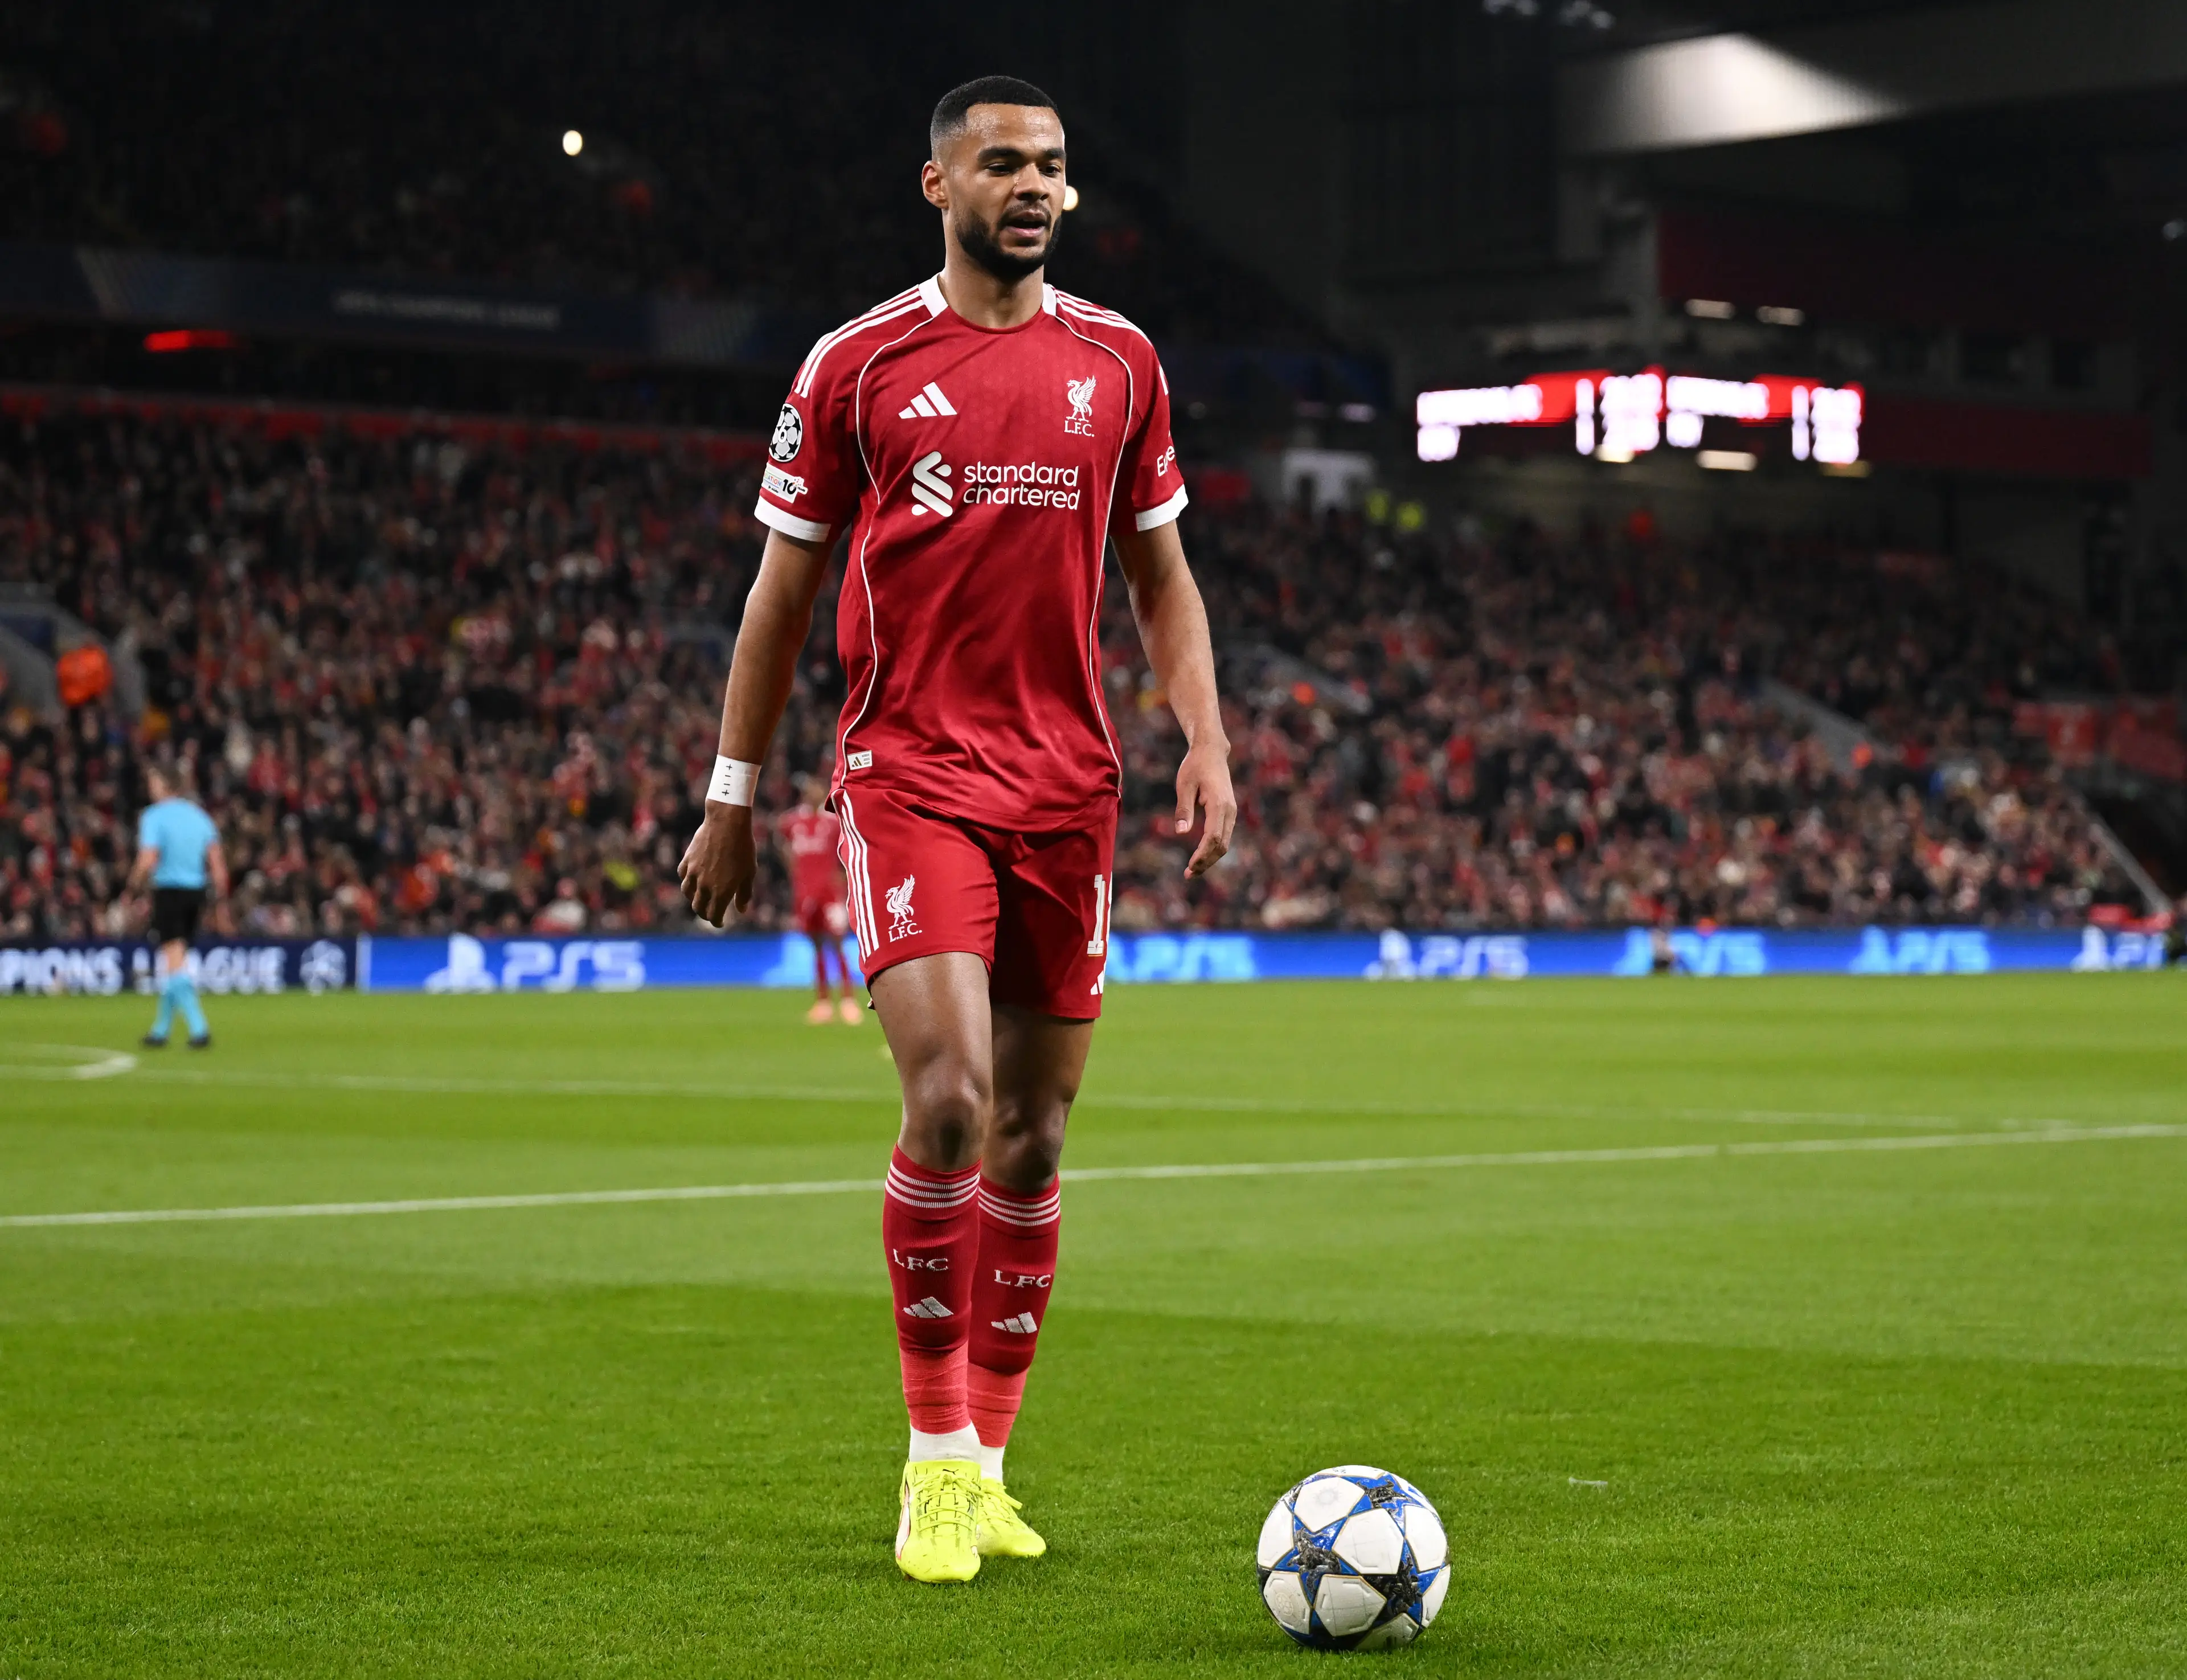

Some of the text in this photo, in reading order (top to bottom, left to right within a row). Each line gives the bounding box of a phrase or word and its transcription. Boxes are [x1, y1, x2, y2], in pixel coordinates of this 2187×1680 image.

[778, 422, 788, 443] 6
[1063, 420, 1095, 437] L.F.C.
[964, 461, 1079, 487] standard
[783, 478, 797, 495] 10
[963, 483, 1080, 511] chartered
[888, 922, 923, 943] L.F.C.
[502, 940, 646, 993] PS5
[1419, 935, 1529, 980] PS5
[892, 1248, 948, 1271] LFC
[994, 1269, 1051, 1288] LFC
